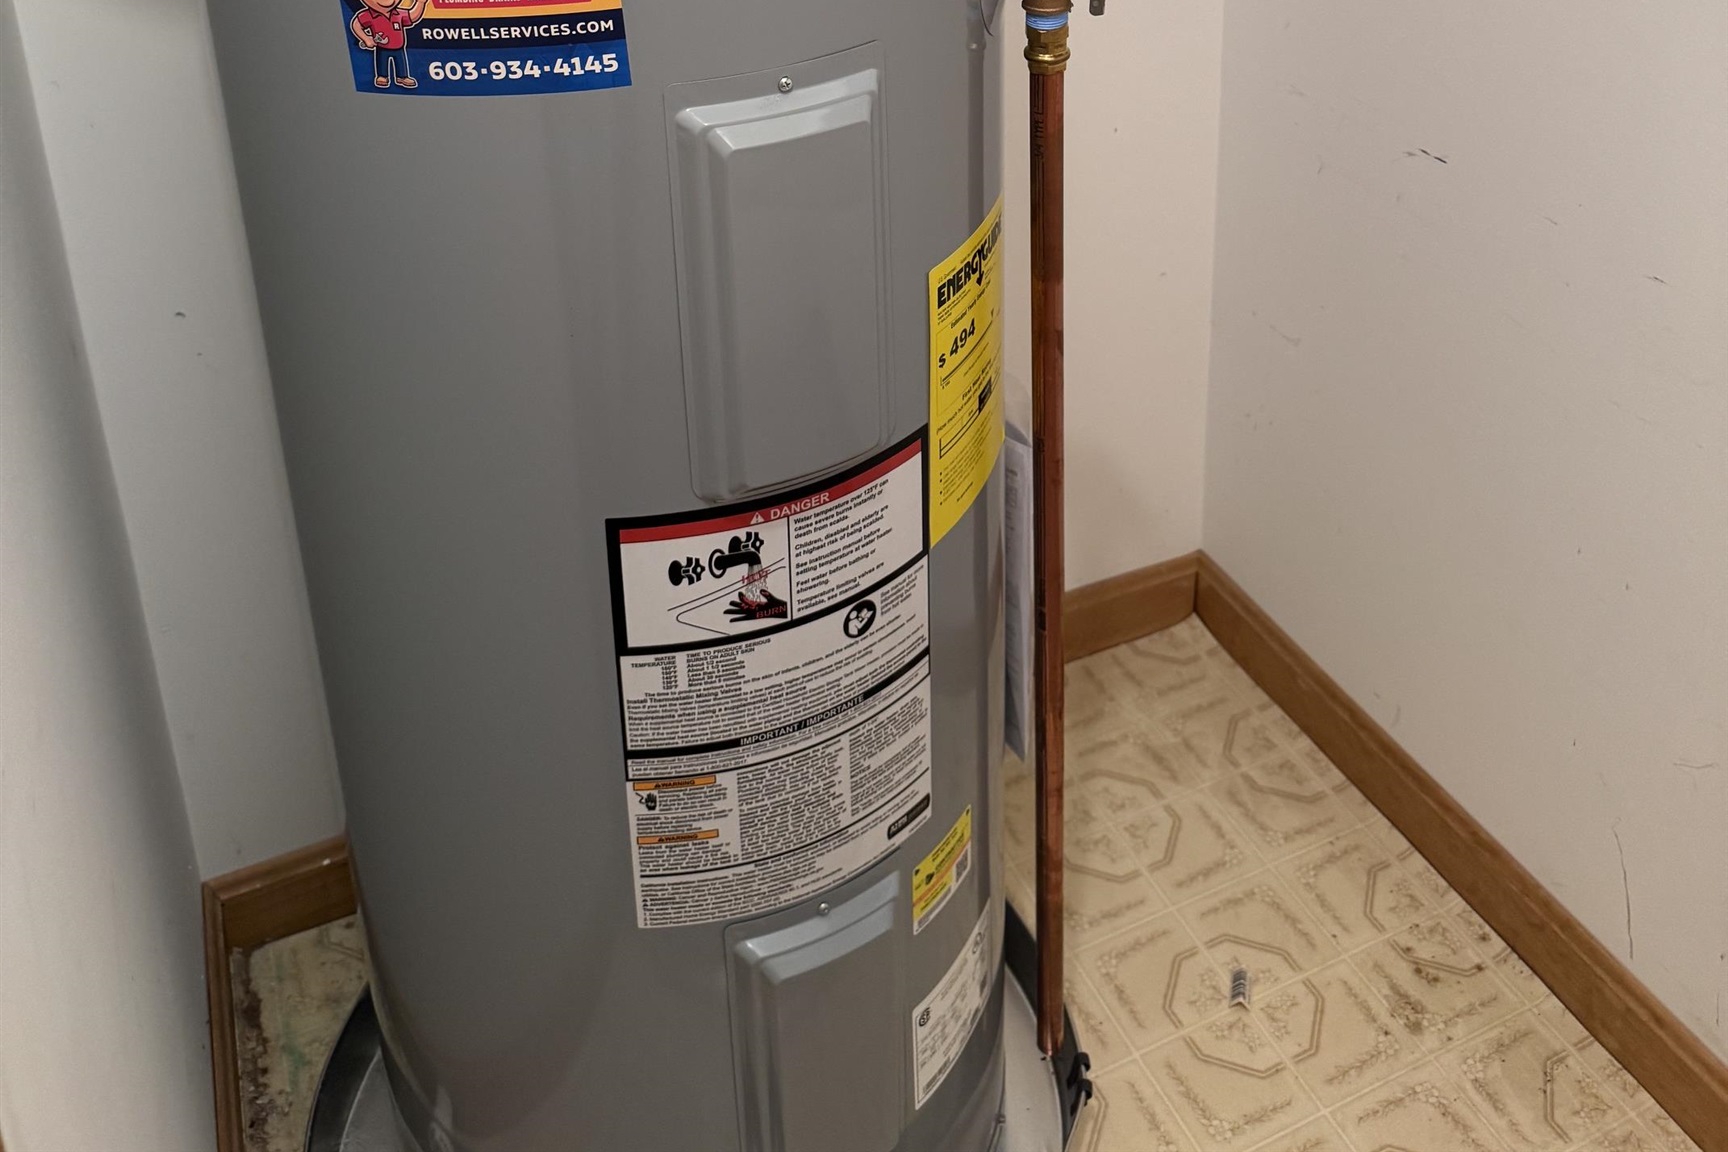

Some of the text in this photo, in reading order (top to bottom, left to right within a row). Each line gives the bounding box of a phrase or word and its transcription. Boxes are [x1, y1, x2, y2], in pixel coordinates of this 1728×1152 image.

[422, 20, 614, 40] ROWELLSERVICES.COM
[950, 318, 975, 358] 494
[770, 492, 830, 520] DANGER
[794, 515, 812, 524] Water
[814, 499, 849, 518] temperature
[850, 493, 863, 502] over
[879, 479, 888, 487] can
[794, 522, 813, 531] cause
[815, 514, 834, 525] severe
[836, 506, 852, 516] burns
[854, 493, 876, 508] instantly
[795, 515, 849, 539] death from scalds.
[795, 537, 823, 551] Children,
[825, 525, 849, 540] disabled
[850, 519, 861, 528] and
[862, 509, 879, 522] elderly
[803, 543, 826, 555] highest
[827, 537, 838, 546] risk
[847, 527, 862, 538] being
[796, 565, 817, 576] setting
[819, 550, 853, 568] temperature
[861, 538, 876, 548] water
[809, 548, 841, 564] instruction
[843, 537, 862, 550] manual
[797, 579, 810, 587] Feel
[811, 572, 828, 581] water
[829, 563, 847, 575] before
[849, 552, 869, 566] bathing
[797, 578, 829, 594] showering.
[797, 588, 835, 605] Temperature
[836, 577, 857, 590] limiting
[858, 568, 875, 578] valves
[756, 605, 786, 618] BURN
[798, 598, 826, 612] available,
[687, 656, 708, 664] BURNS
[720, 650, 739, 658] ADULT
[713, 645, 743, 655] PRODUCE
[745, 638, 771, 648] SERIOUS
[631, 660, 676, 668] TEMPERATURE
[740, 723, 799, 745] IMPORTANT
[806, 694, 864, 726] IMPORTANTE
